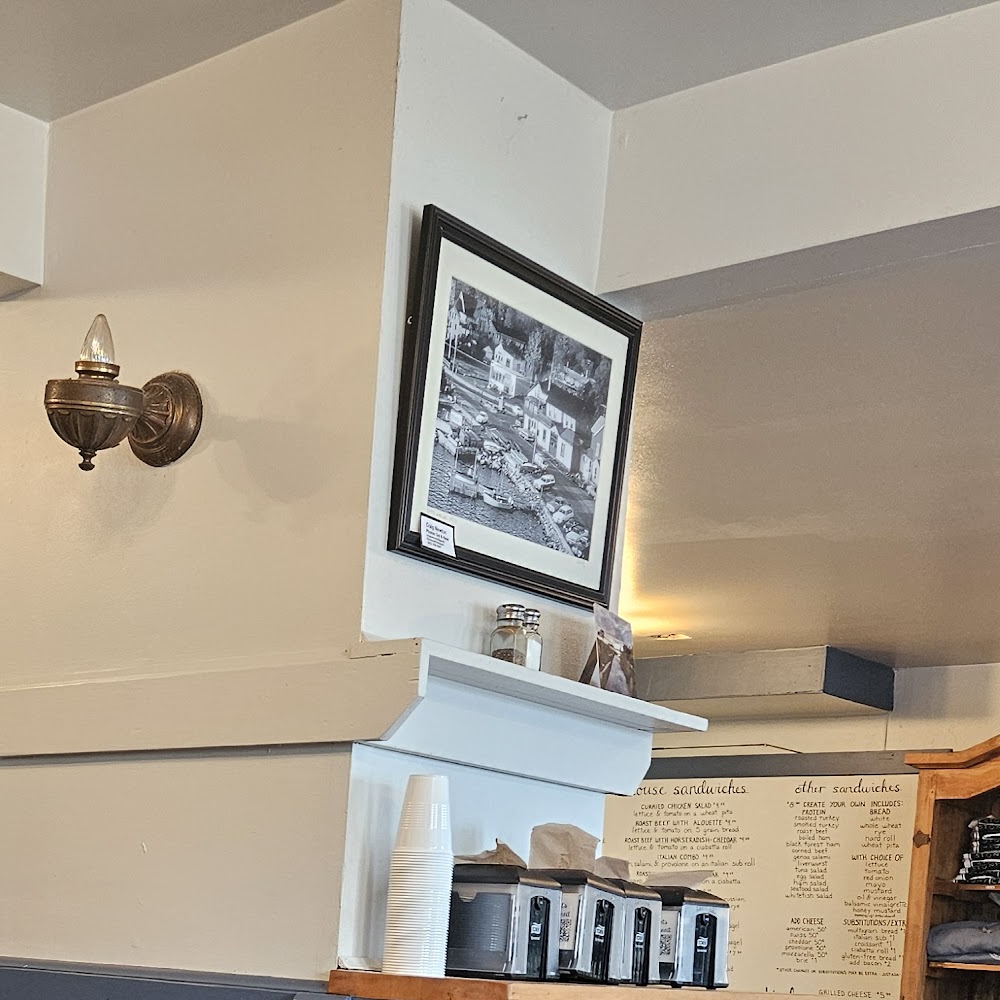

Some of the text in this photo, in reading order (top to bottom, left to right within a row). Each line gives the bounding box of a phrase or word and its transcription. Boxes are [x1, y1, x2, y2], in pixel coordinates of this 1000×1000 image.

[634, 779, 748, 796] ouse sandwiches
[795, 778, 900, 794] other sandwiches
[732, 858, 743, 866] sub
[744, 857, 756, 866] roll
[842, 919, 907, 927] SUBSTITUTIONS/EXTR
[819, 989, 845, 997] GRILLED
